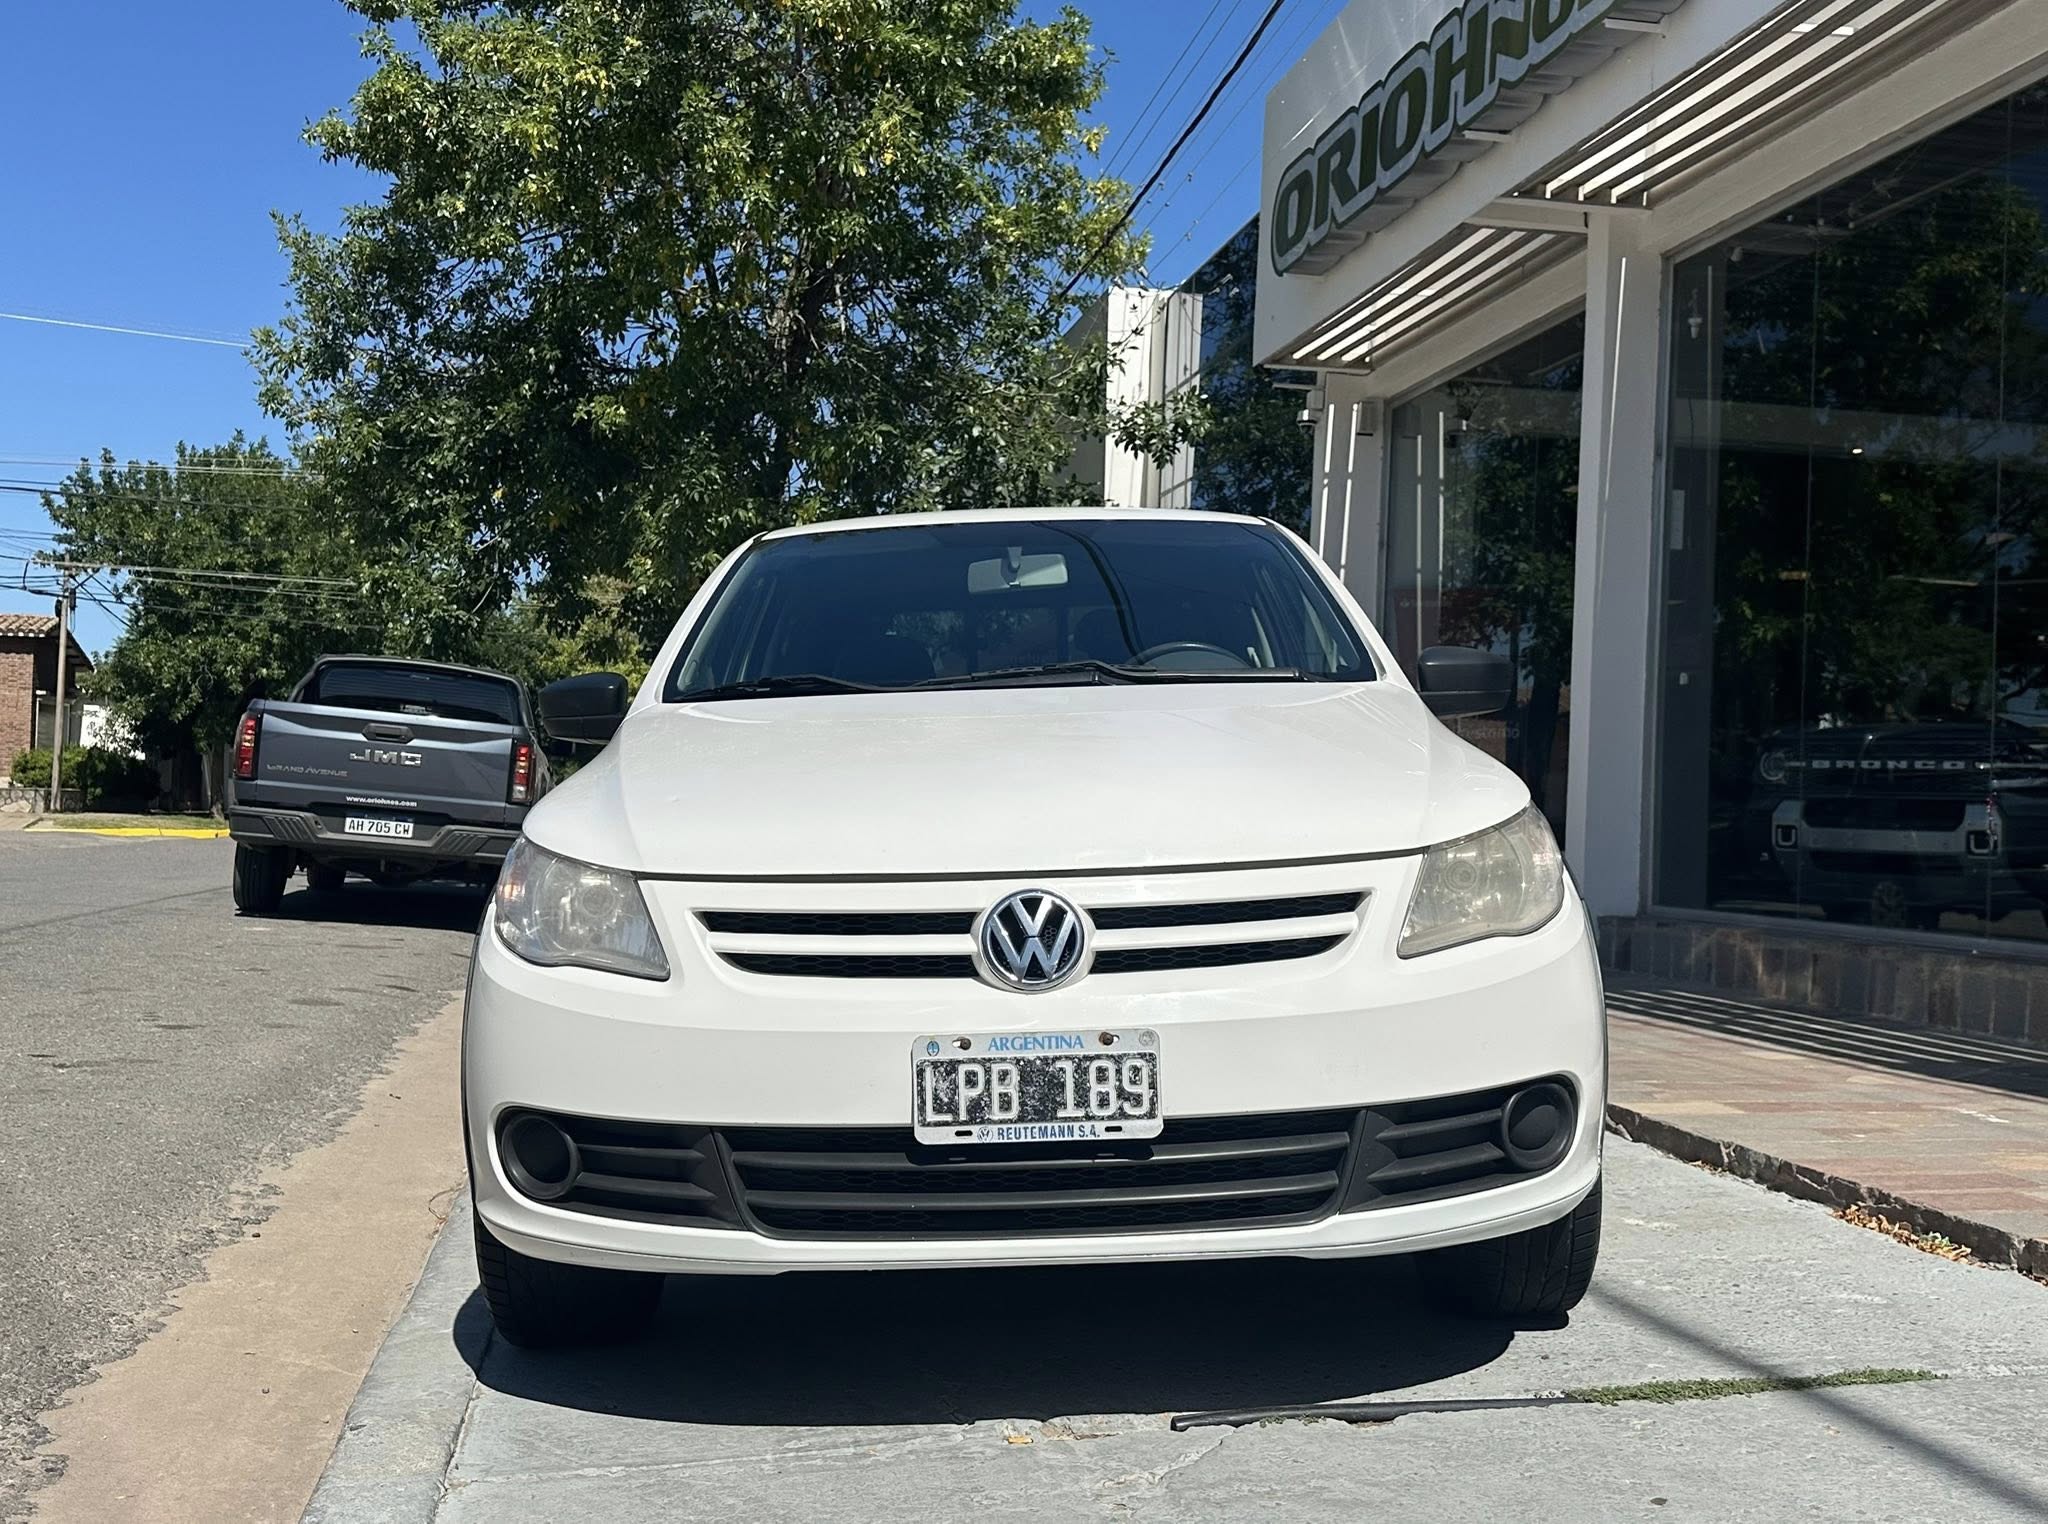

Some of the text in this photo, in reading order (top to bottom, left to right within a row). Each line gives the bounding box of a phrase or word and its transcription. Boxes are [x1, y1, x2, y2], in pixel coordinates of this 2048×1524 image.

[349, 749, 422, 766] JMC
[1812, 759, 1966, 770] BRONCO
[305, 766, 349, 777] AVENUE
[348, 819, 364, 831] AH
[367, 820, 391, 834] 705
[986, 892, 1078, 983] VW
[987, 1034, 1084, 1052] ARGENTINA
[924, 1058, 1151, 1122] LPB 189
[1078, 1123, 1101, 1138] S.A.
